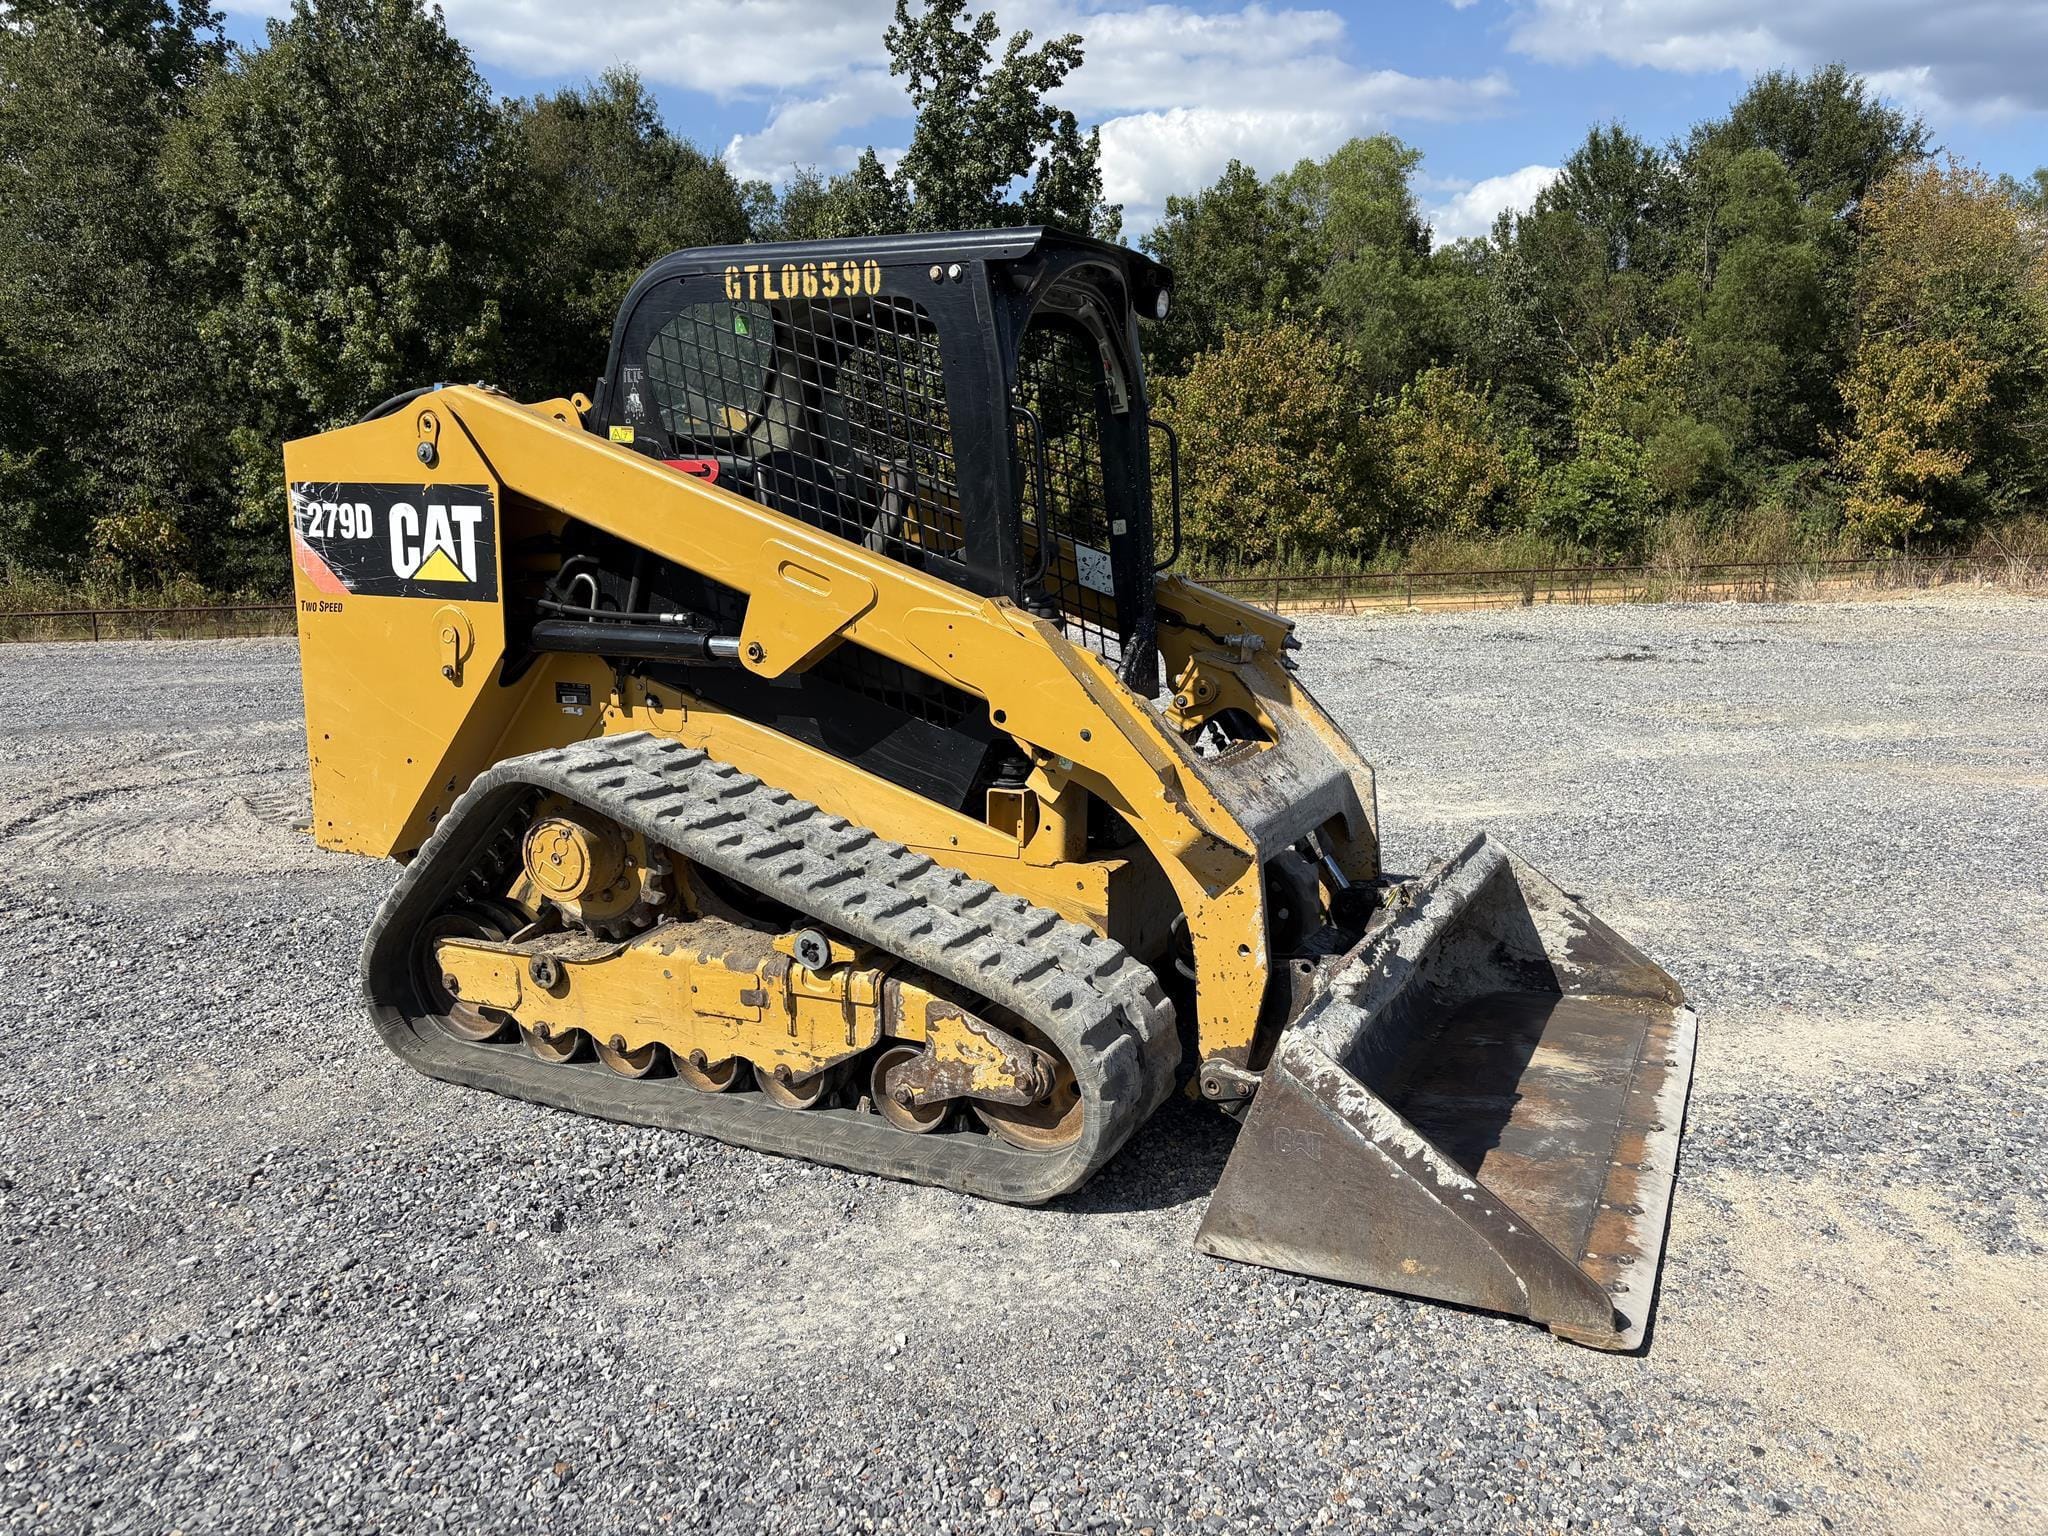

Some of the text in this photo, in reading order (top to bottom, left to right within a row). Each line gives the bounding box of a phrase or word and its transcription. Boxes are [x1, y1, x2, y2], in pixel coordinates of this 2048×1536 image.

[724, 259, 881, 300] GTL06590
[307, 502, 373, 539] 279D
[389, 502, 482, 583] CAT
[1273, 1126, 1324, 1161] CAT
